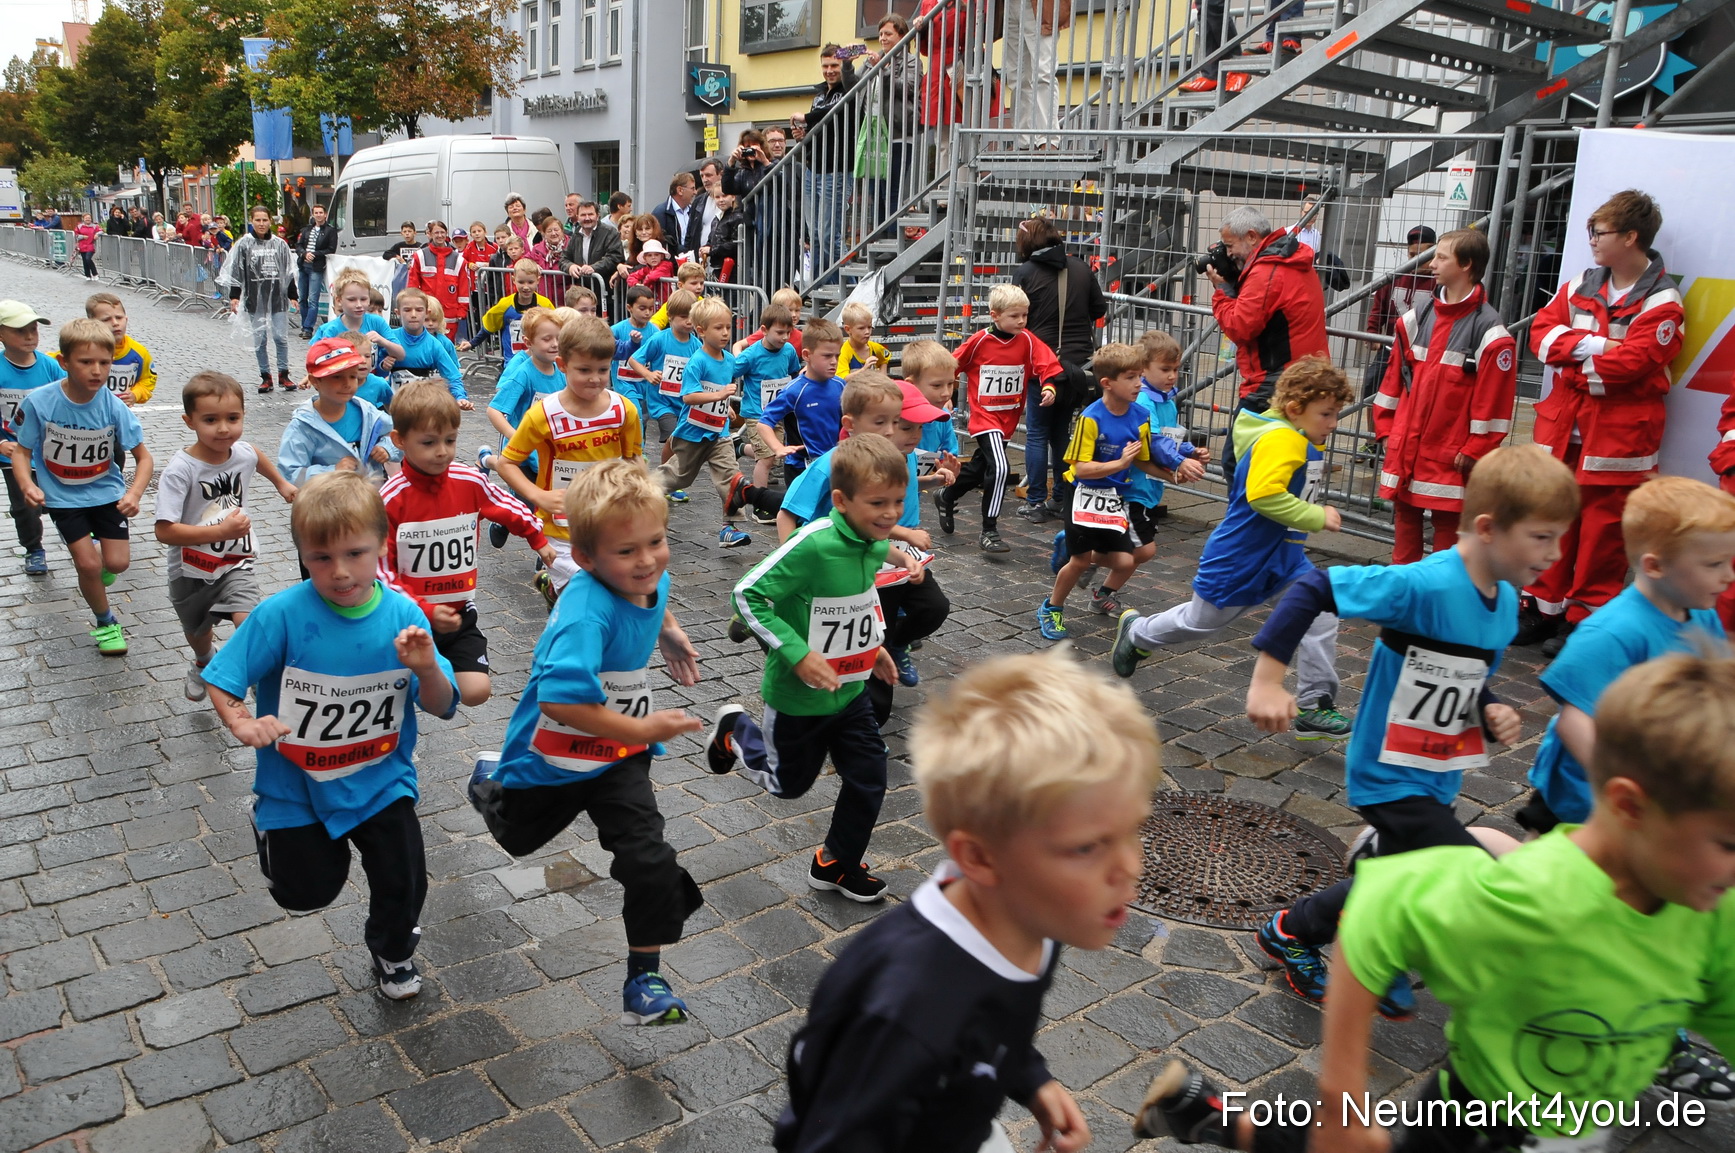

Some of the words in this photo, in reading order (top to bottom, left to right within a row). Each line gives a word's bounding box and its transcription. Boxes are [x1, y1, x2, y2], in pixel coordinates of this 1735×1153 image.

[704, 76, 721, 98] G2
[107, 374, 135, 393] 094
[668, 365, 684, 382] 75
[985, 375, 1020, 394] 7161
[6, 401, 19, 419] 7
[47, 428, 69, 440] PARTL
[70, 433, 106, 442] Neumarkt
[555, 440, 588, 453] MAX
[592, 432, 621, 447] BÖG
[51, 439, 109, 464] 7146
[399, 530, 431, 540] PARTL
[433, 524, 469, 537] Neumarkt
[408, 535, 474, 573] 7095
[424, 578, 464, 592] Franko
[813, 606, 848, 616] PARTL
[821, 614, 879, 654] 719
[837, 659, 865, 673] Felix
[1406, 658, 1450, 679] PARTL
[285, 678, 328, 697] PARTL
[330, 681, 389, 698] Neumarkt
[1407, 680, 1476, 728] 704
[295, 695, 395, 742] 7224
[305, 744, 375, 768] Benedikt
